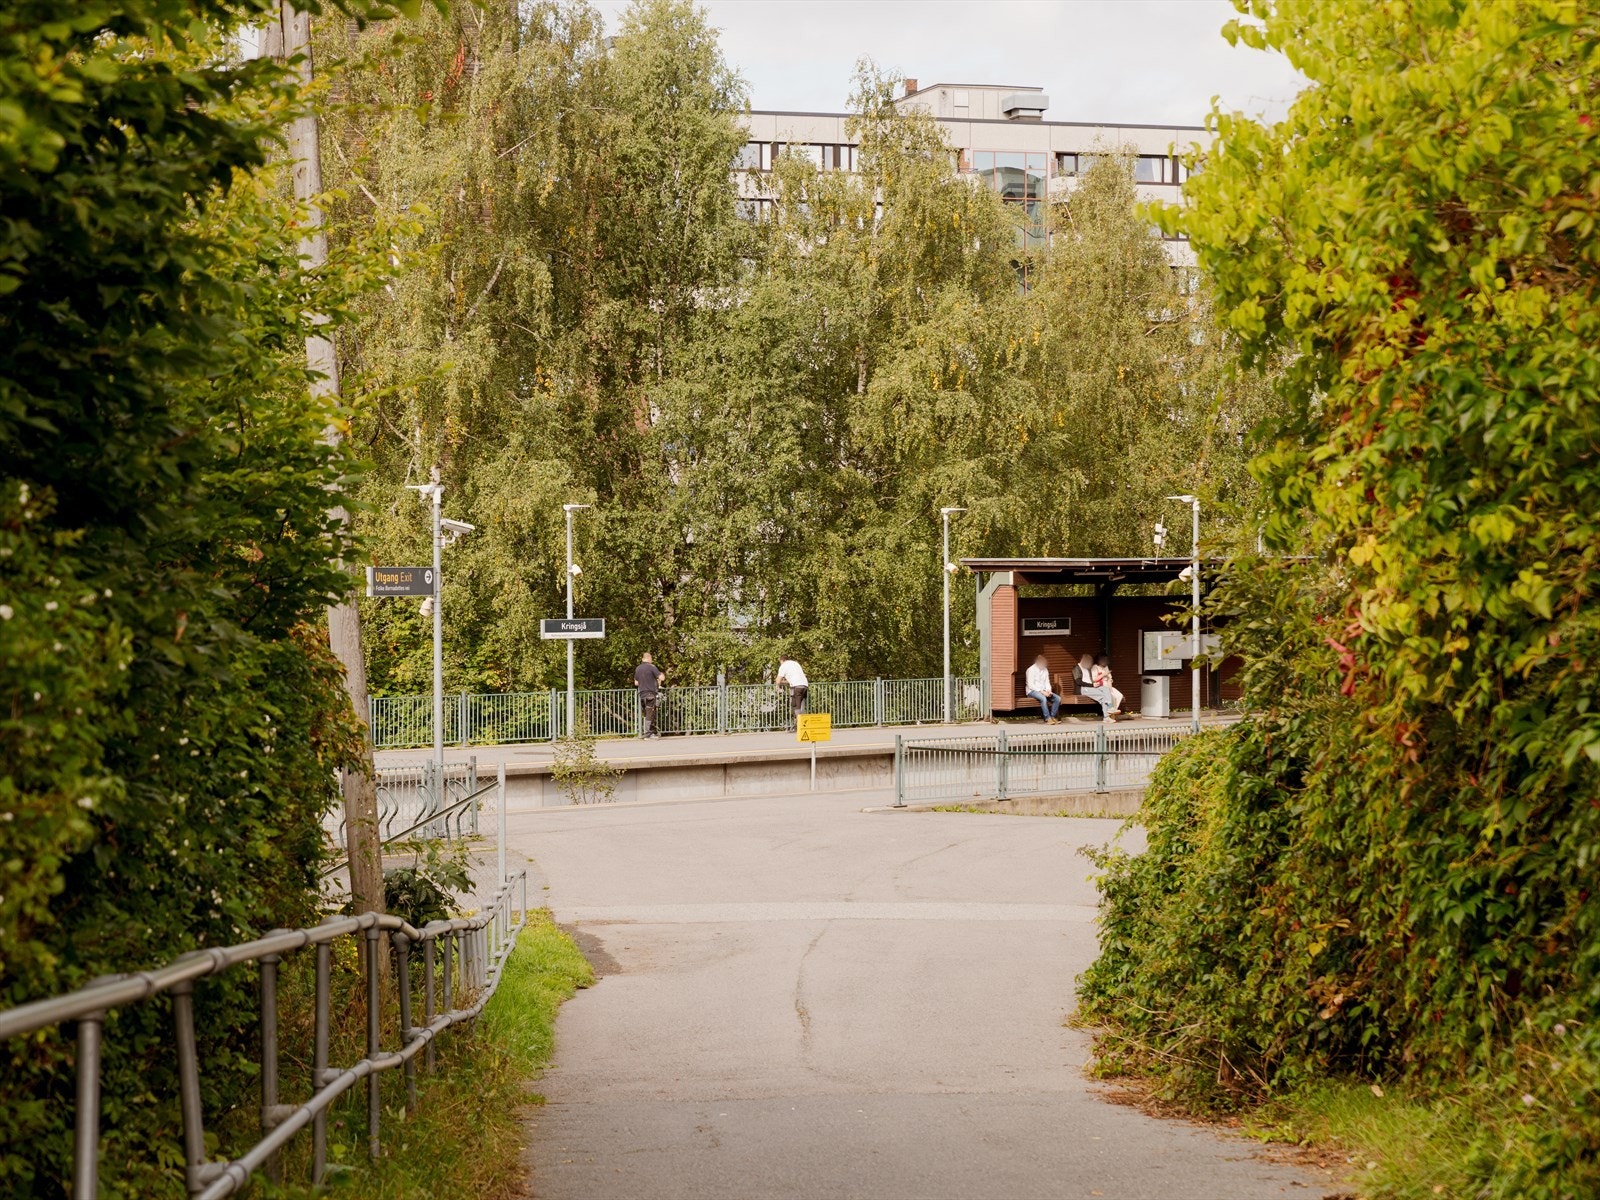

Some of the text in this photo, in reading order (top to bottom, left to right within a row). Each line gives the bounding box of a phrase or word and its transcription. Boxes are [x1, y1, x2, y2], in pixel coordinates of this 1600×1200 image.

[375, 572, 413, 584] Utgang Exit
[561, 621, 587, 631] Kringsjå
[1036, 620, 1057, 629] Kringsjå
